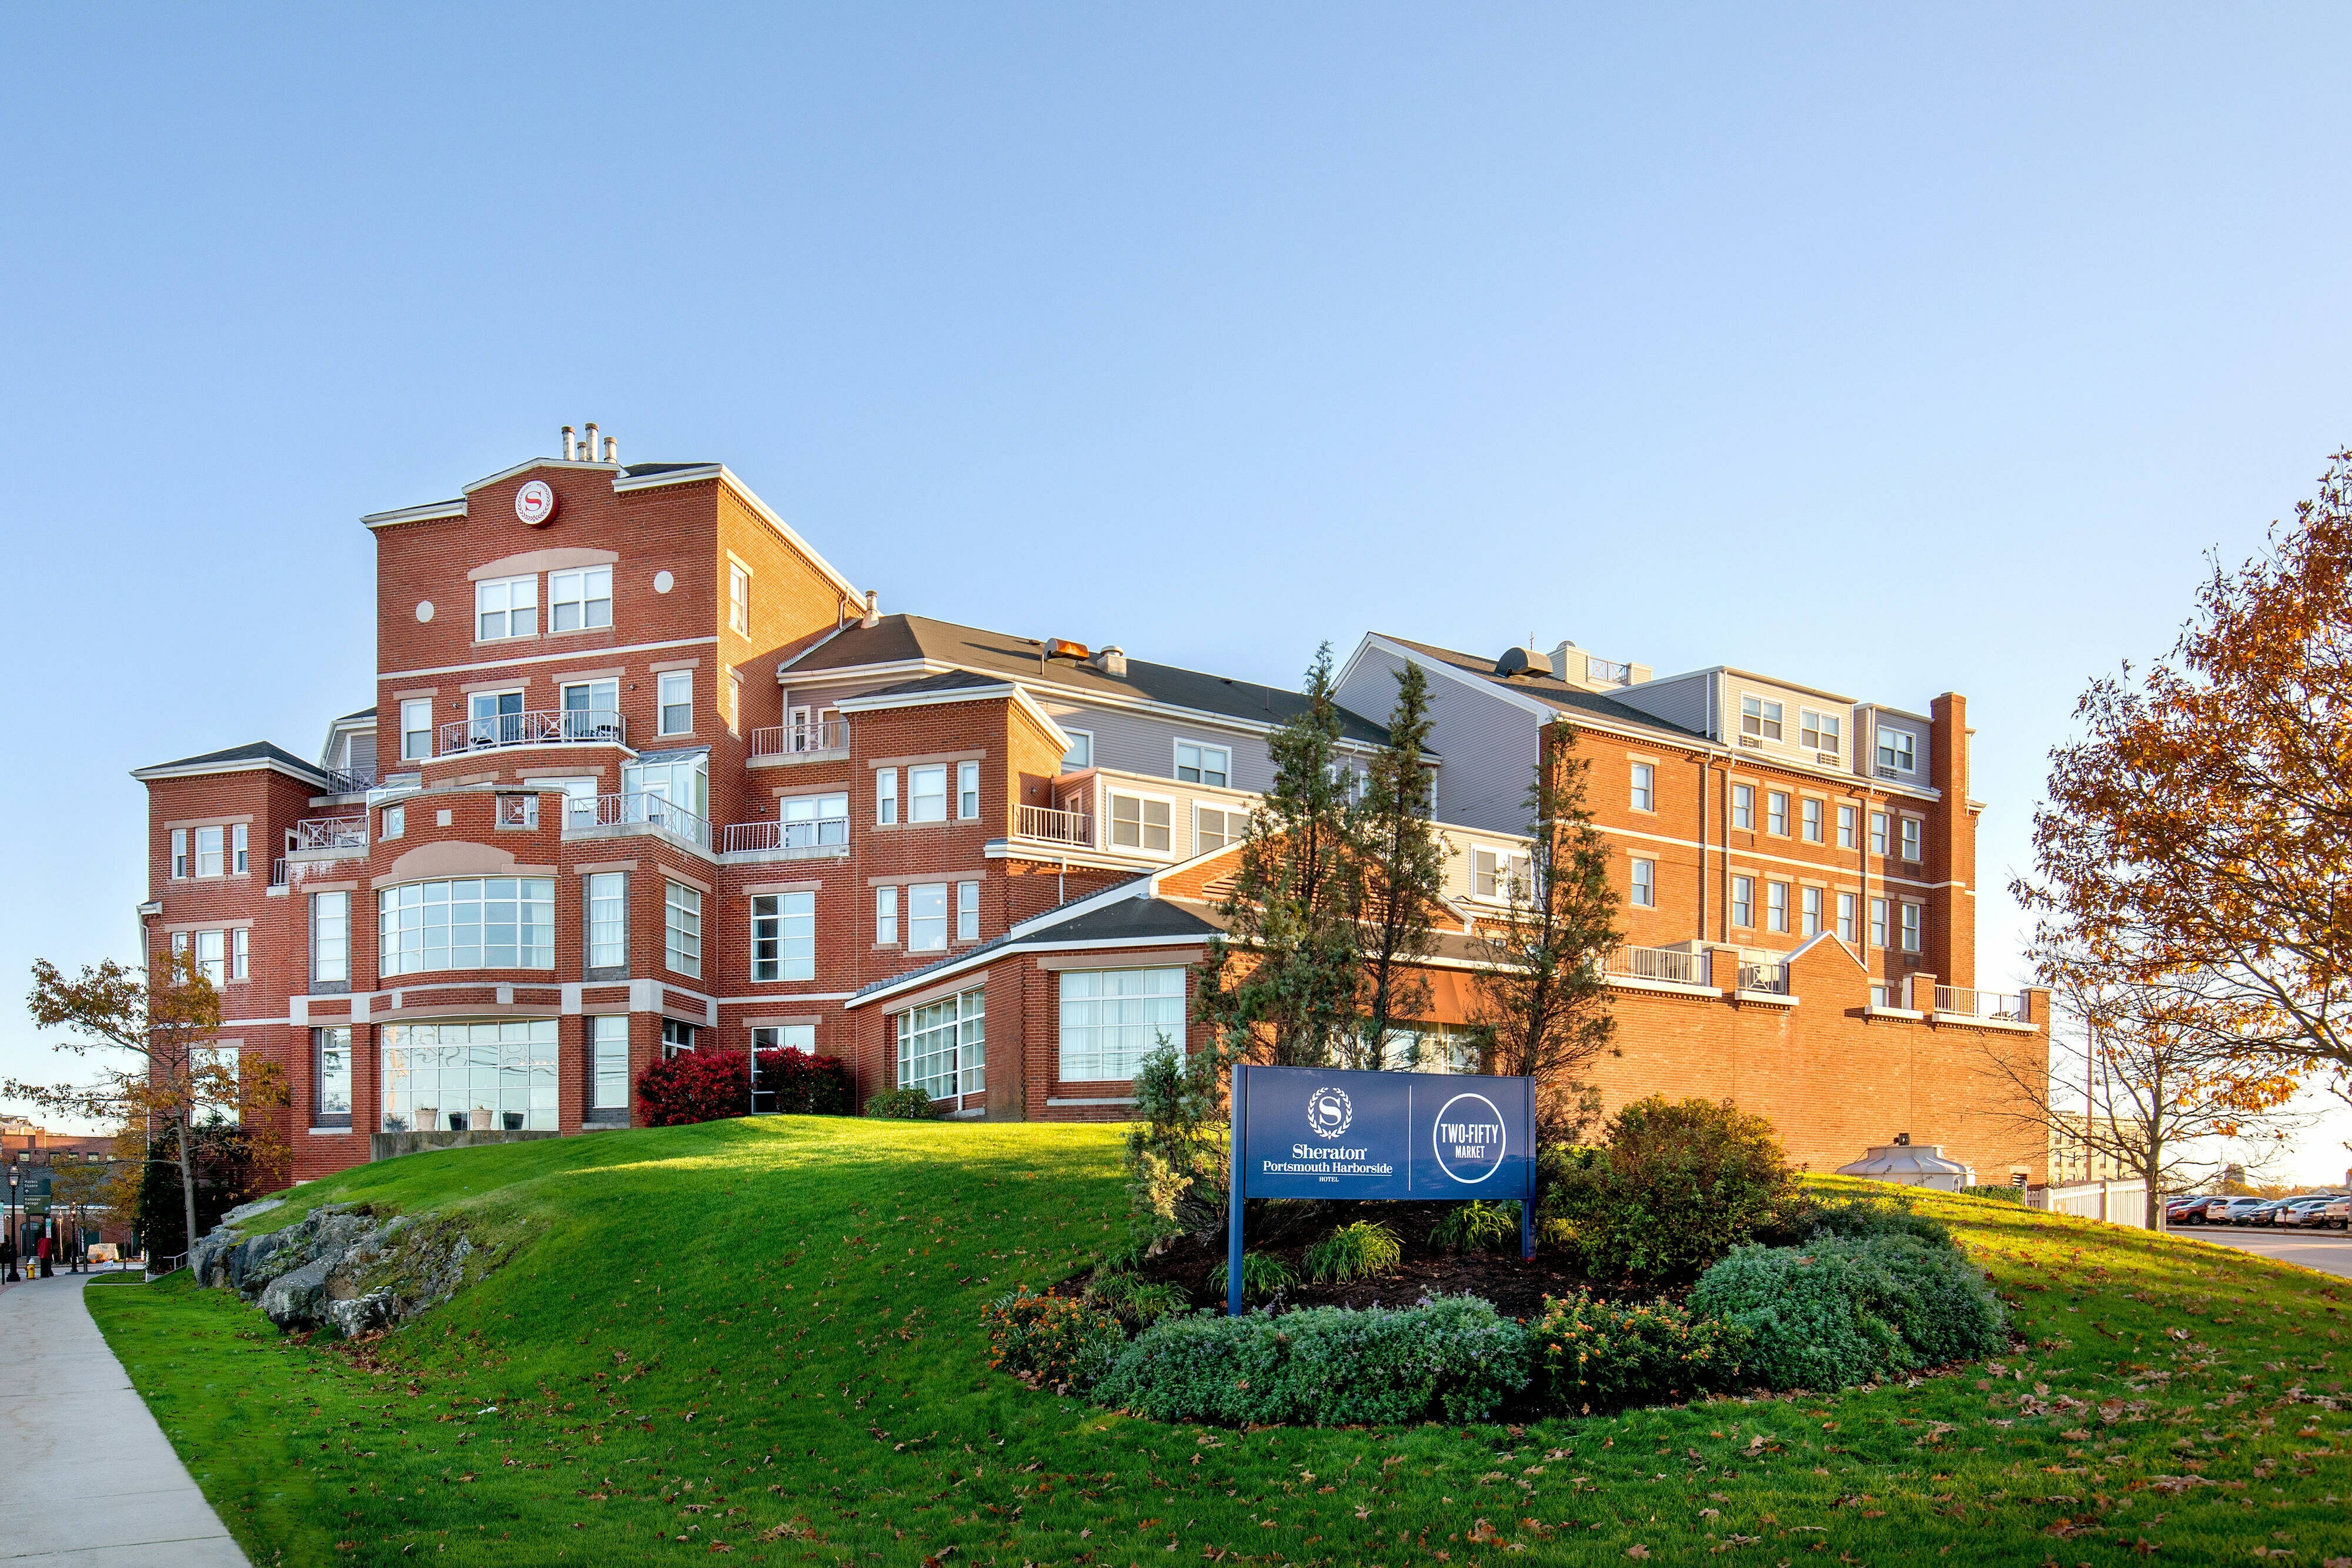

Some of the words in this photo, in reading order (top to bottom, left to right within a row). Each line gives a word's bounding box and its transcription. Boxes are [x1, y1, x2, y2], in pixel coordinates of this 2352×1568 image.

[524, 490, 542, 511] S
[1318, 1096, 1342, 1126] S
[1441, 1124, 1499, 1144] TWO-FIFTY
[1292, 1144, 1366, 1160] Sheraton
[1455, 1145, 1485, 1158] MARKET
[1263, 1161, 1330, 1172] Portsmouth
[1332, 1162, 1393, 1174] Harborside
